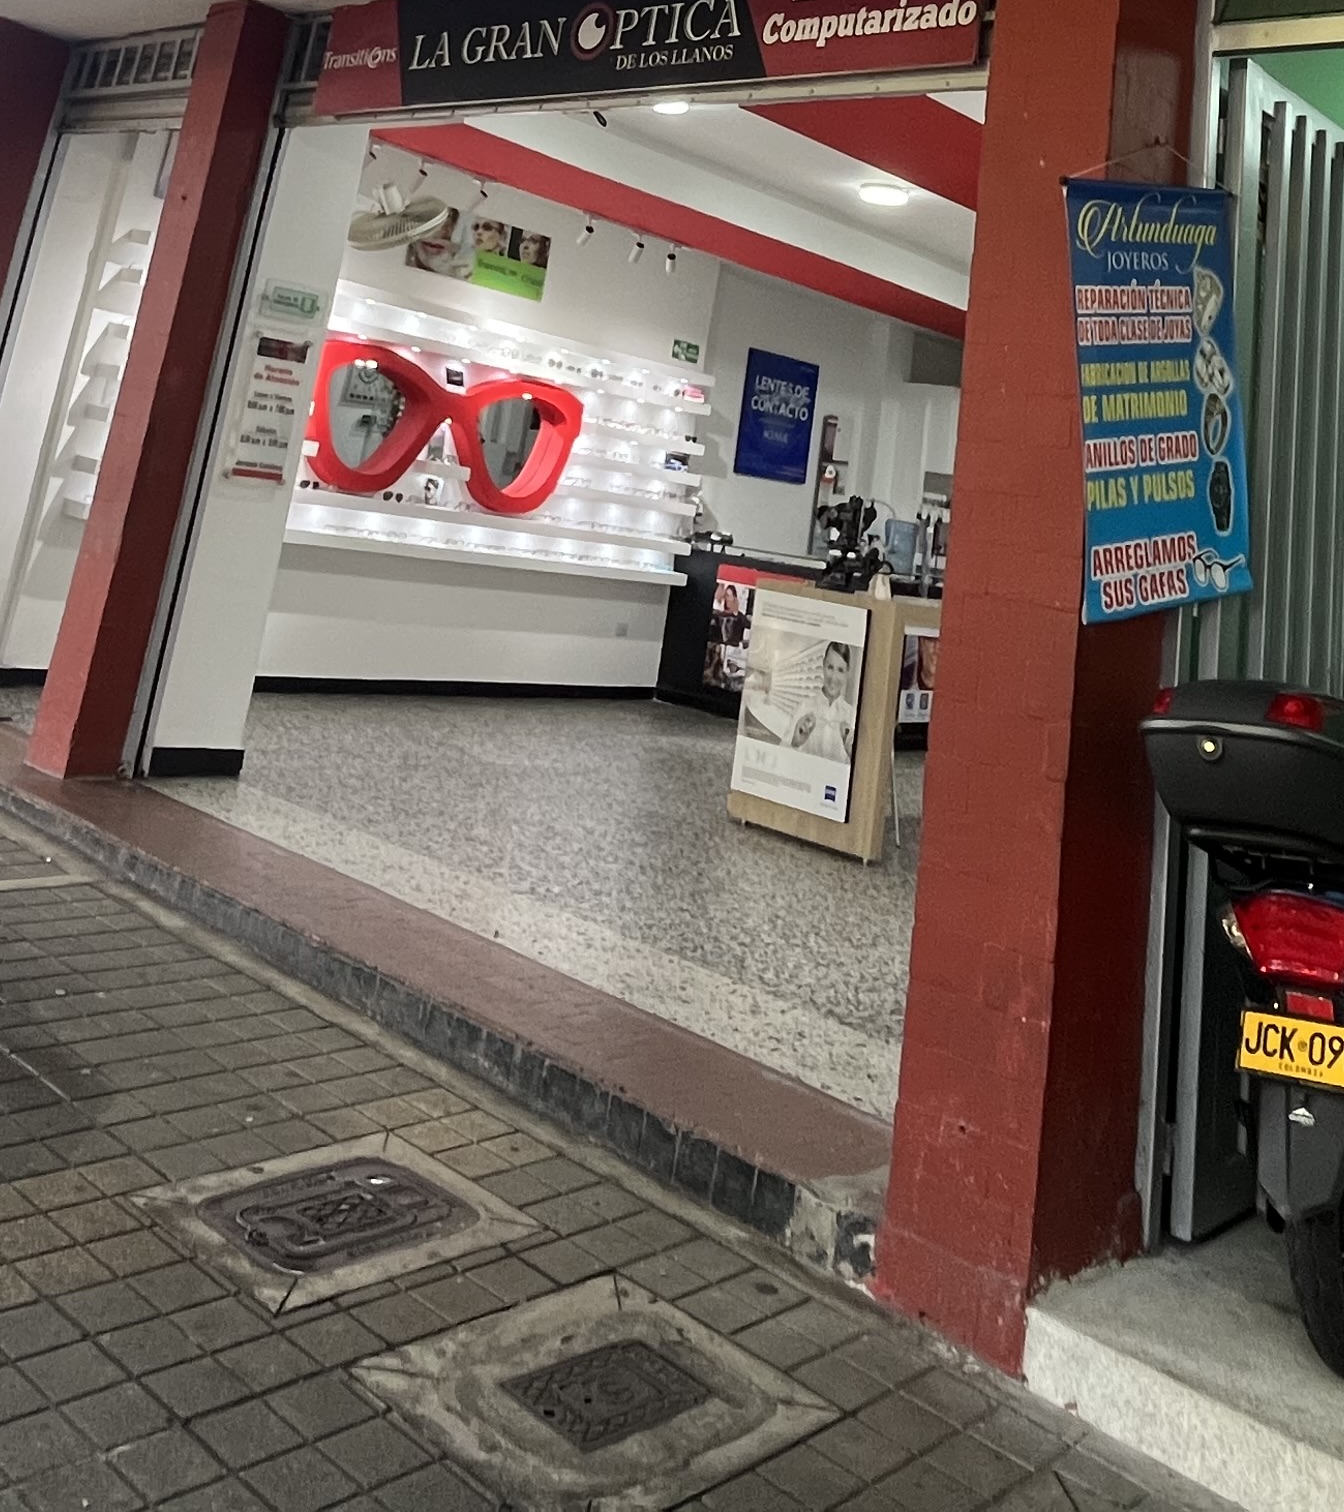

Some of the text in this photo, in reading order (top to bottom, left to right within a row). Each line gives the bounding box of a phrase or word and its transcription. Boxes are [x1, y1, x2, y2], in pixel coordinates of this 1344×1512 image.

[324, 45, 397, 69] Transitions
[409, 31, 452, 70] LA
[461, 17, 567, 64] GRAN
[616, 44, 734, 70] DE LOS LLANOS
[1107, 251, 1169, 272] JOYEROS
[1148, 279, 1192, 312] TÉCNICA
[1078, 316, 1191, 344] DE TODA CLASE DE JOYAS
[755, 375, 793, 393] LENTES
[751, 395, 809, 422] CONTACTO
[1083, 389, 1187, 423] DE MATRIMONIO
[1086, 433, 1197, 470] ANILLOS DE GRADO
[1088, 469, 1195, 511] PILAS Y PULSOS
[1093, 533, 1196, 578] ARREGLAMOS
[1103, 567, 1187, 610] SUS GAFAS
[1245, 1021, 1298, 1063] JCK
